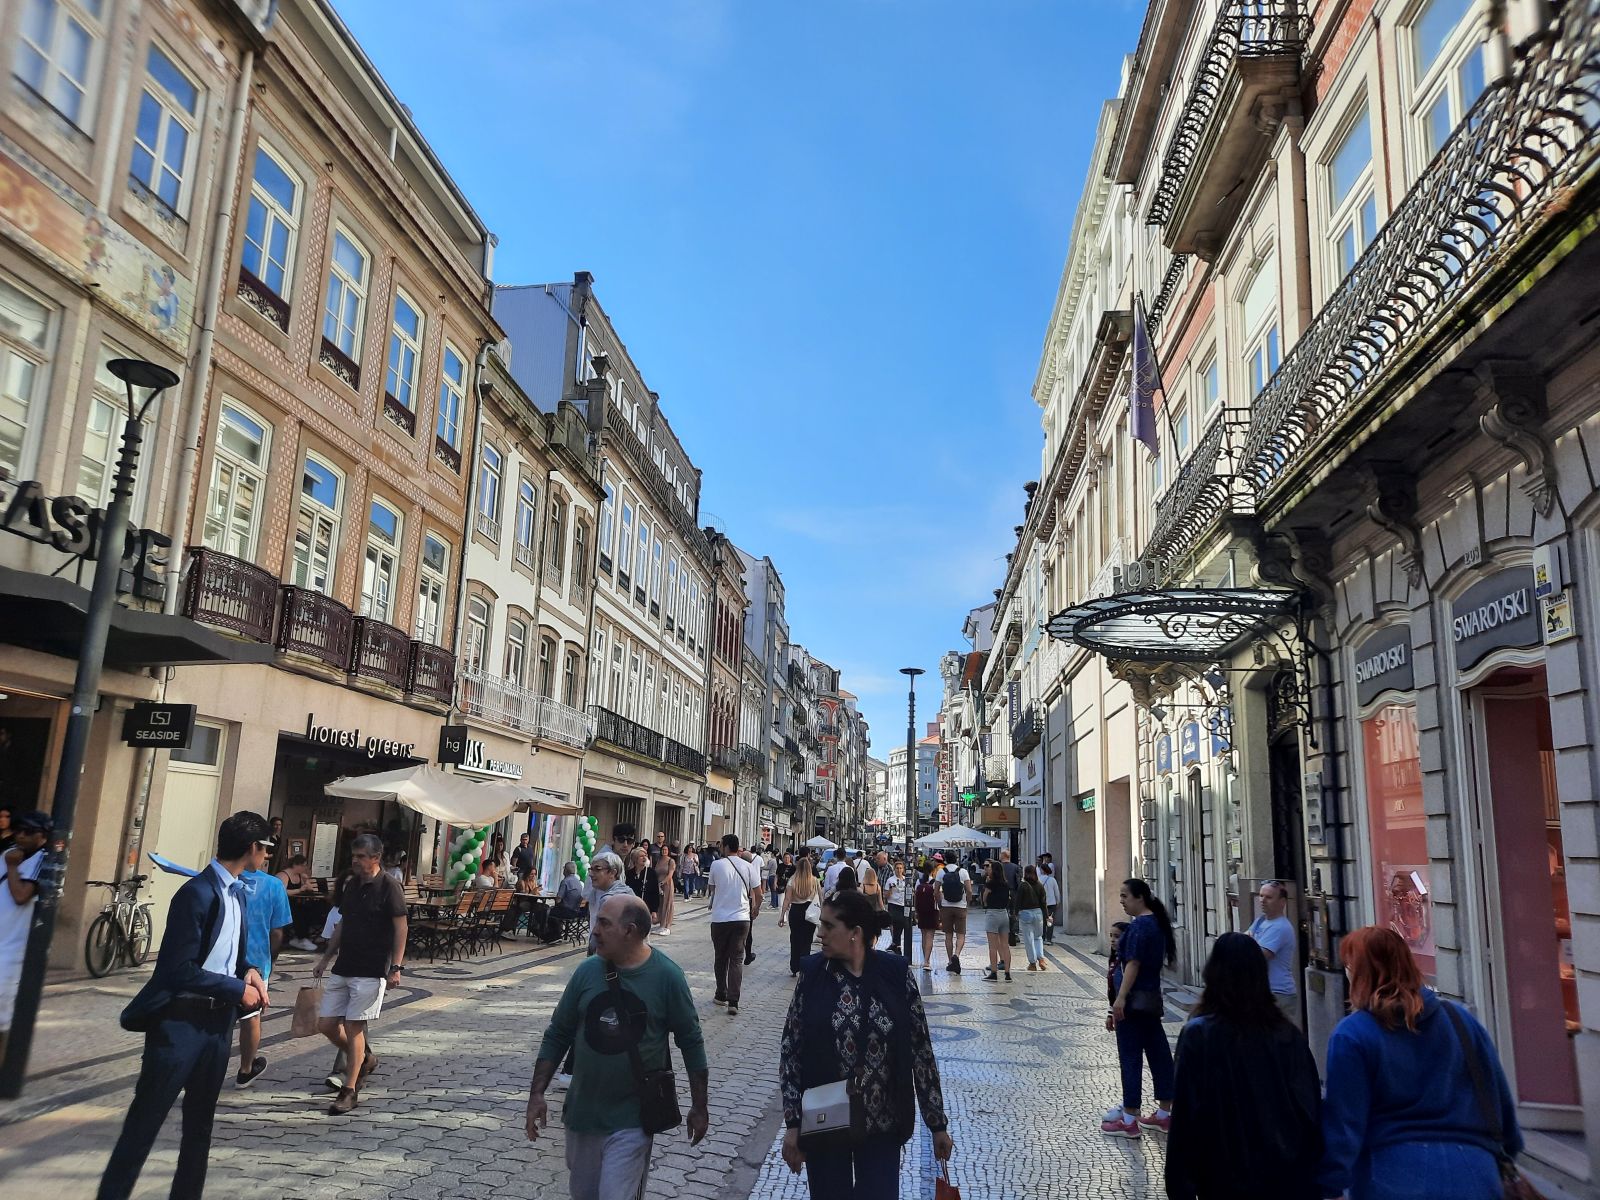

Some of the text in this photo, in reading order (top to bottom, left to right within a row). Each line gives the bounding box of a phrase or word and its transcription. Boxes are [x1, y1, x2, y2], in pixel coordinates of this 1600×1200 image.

[1454, 588, 1529, 641] SWAROVSKI
[1356, 643, 1405, 683] SWAROVSKI
[136, 730, 181, 740] SEASIDE
[306, 713, 415, 759] honest greens
[445, 737, 460, 753] hg
